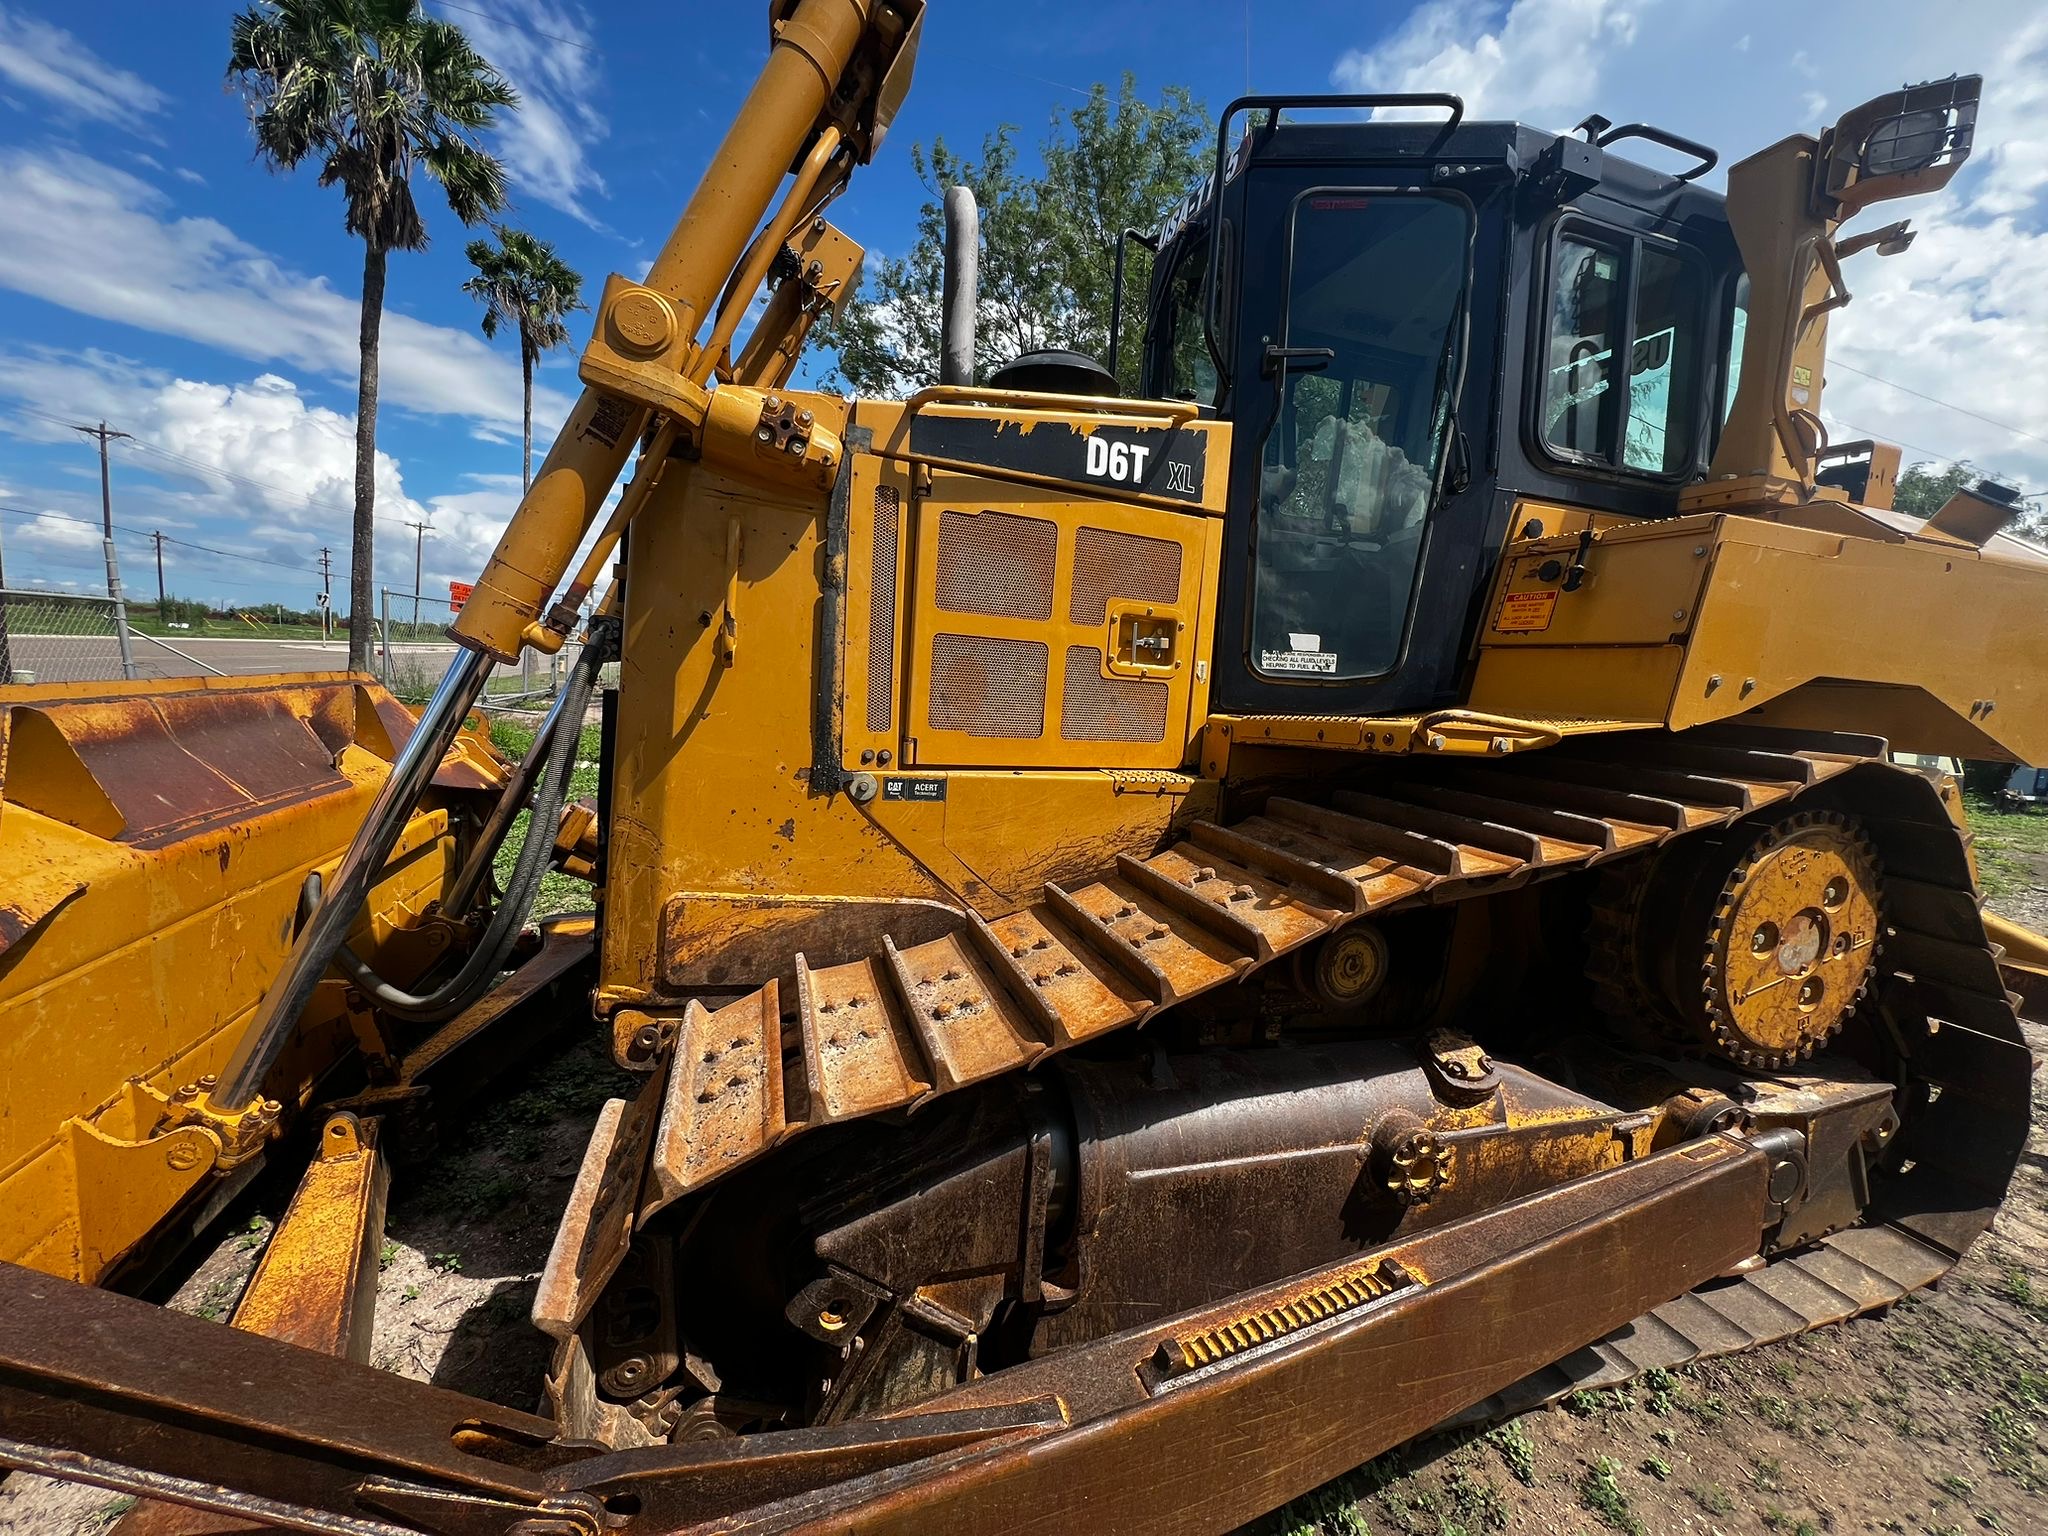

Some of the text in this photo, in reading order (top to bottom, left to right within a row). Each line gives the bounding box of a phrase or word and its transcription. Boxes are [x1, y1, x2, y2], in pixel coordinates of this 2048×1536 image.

[1158, 154, 1238, 251] USA-115
[1086, 435, 1195, 493] D6T XL
[887, 782, 939, 791] CAT ACERT
